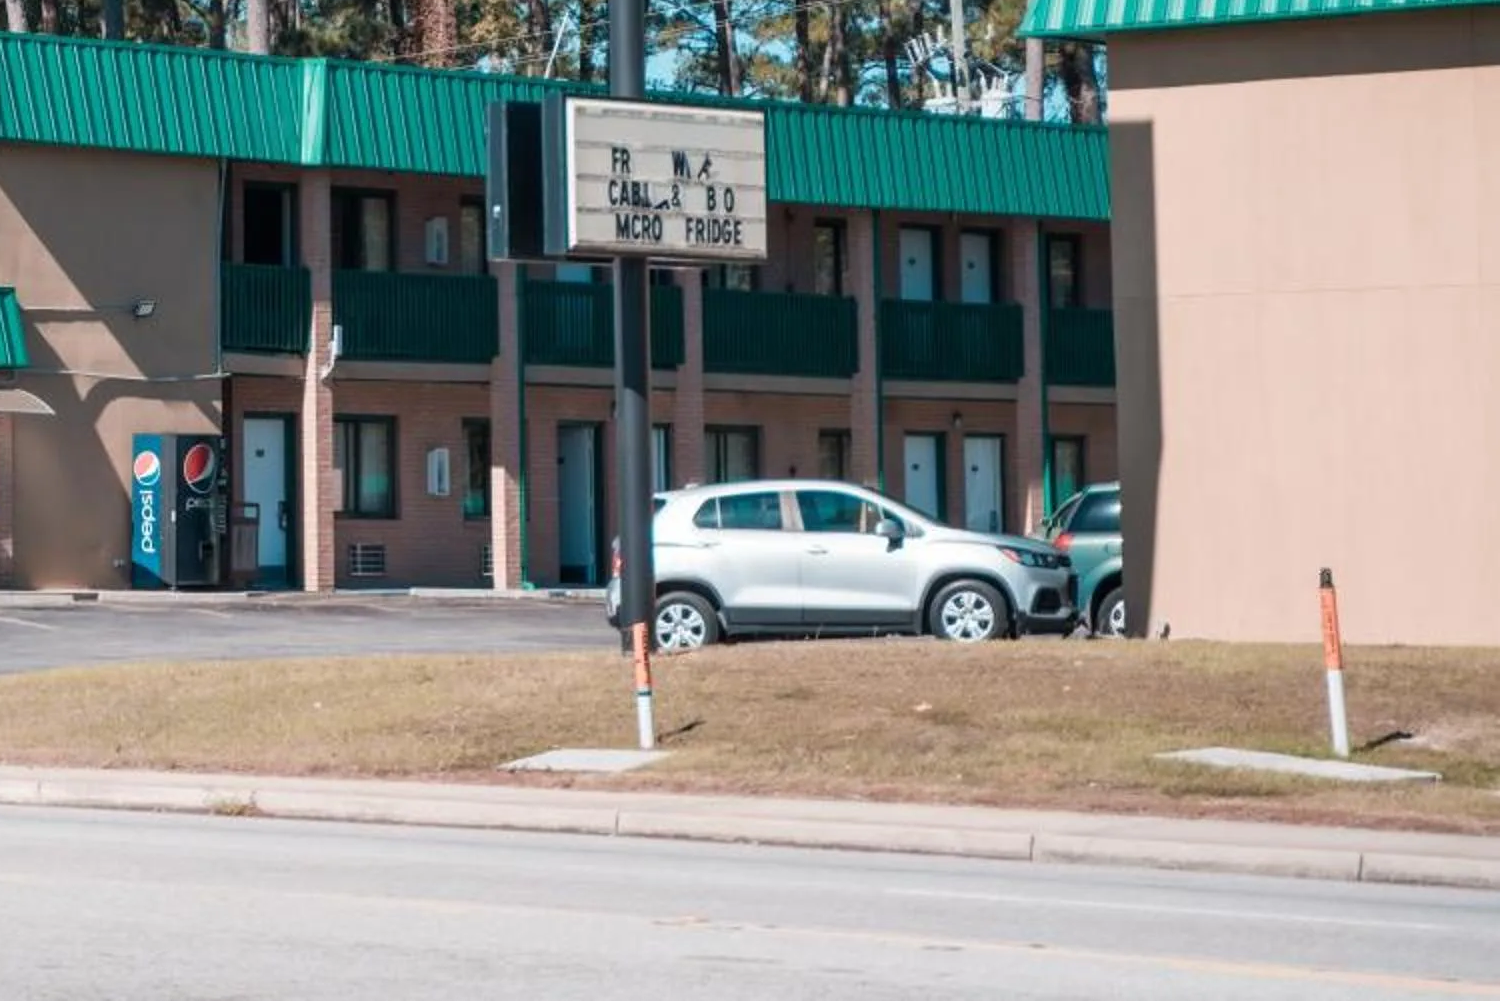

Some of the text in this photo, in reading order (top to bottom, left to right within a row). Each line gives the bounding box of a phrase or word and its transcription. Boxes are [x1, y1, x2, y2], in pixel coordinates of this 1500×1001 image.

[615, 213, 742, 245] MCRO FRIDGE
[139, 490, 157, 553] pepsi
